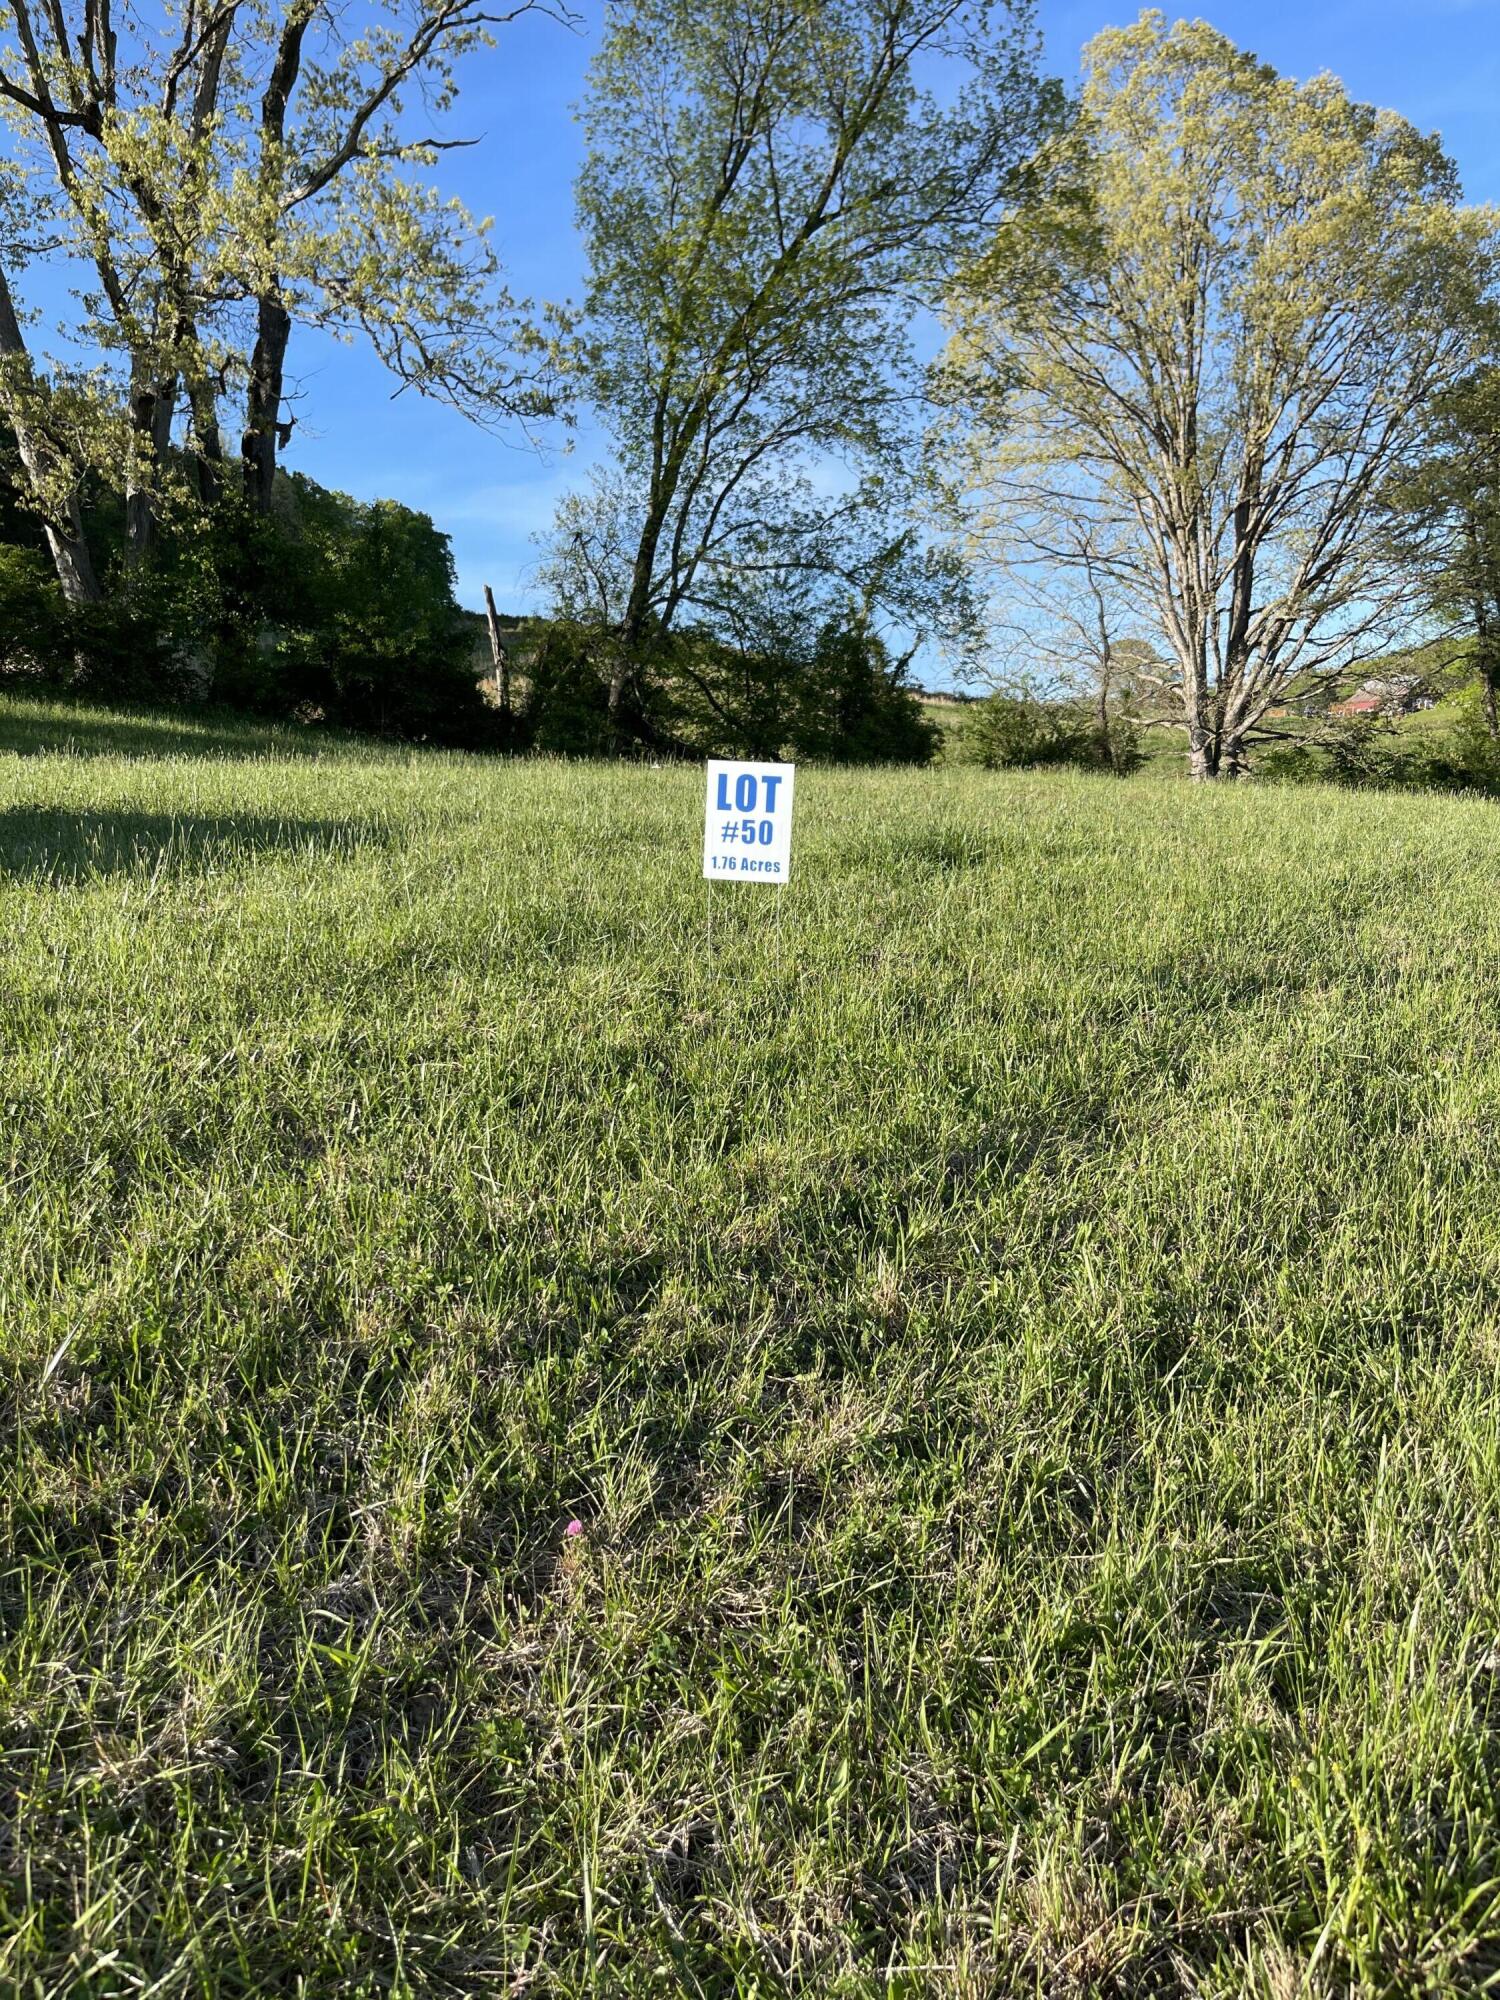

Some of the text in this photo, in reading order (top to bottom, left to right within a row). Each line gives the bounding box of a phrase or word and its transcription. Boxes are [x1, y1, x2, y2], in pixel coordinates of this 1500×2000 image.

[717, 773, 782, 813] LOT
[721, 819, 773, 845] #50
[712, 856, 781, 873] 1.76 Acres
